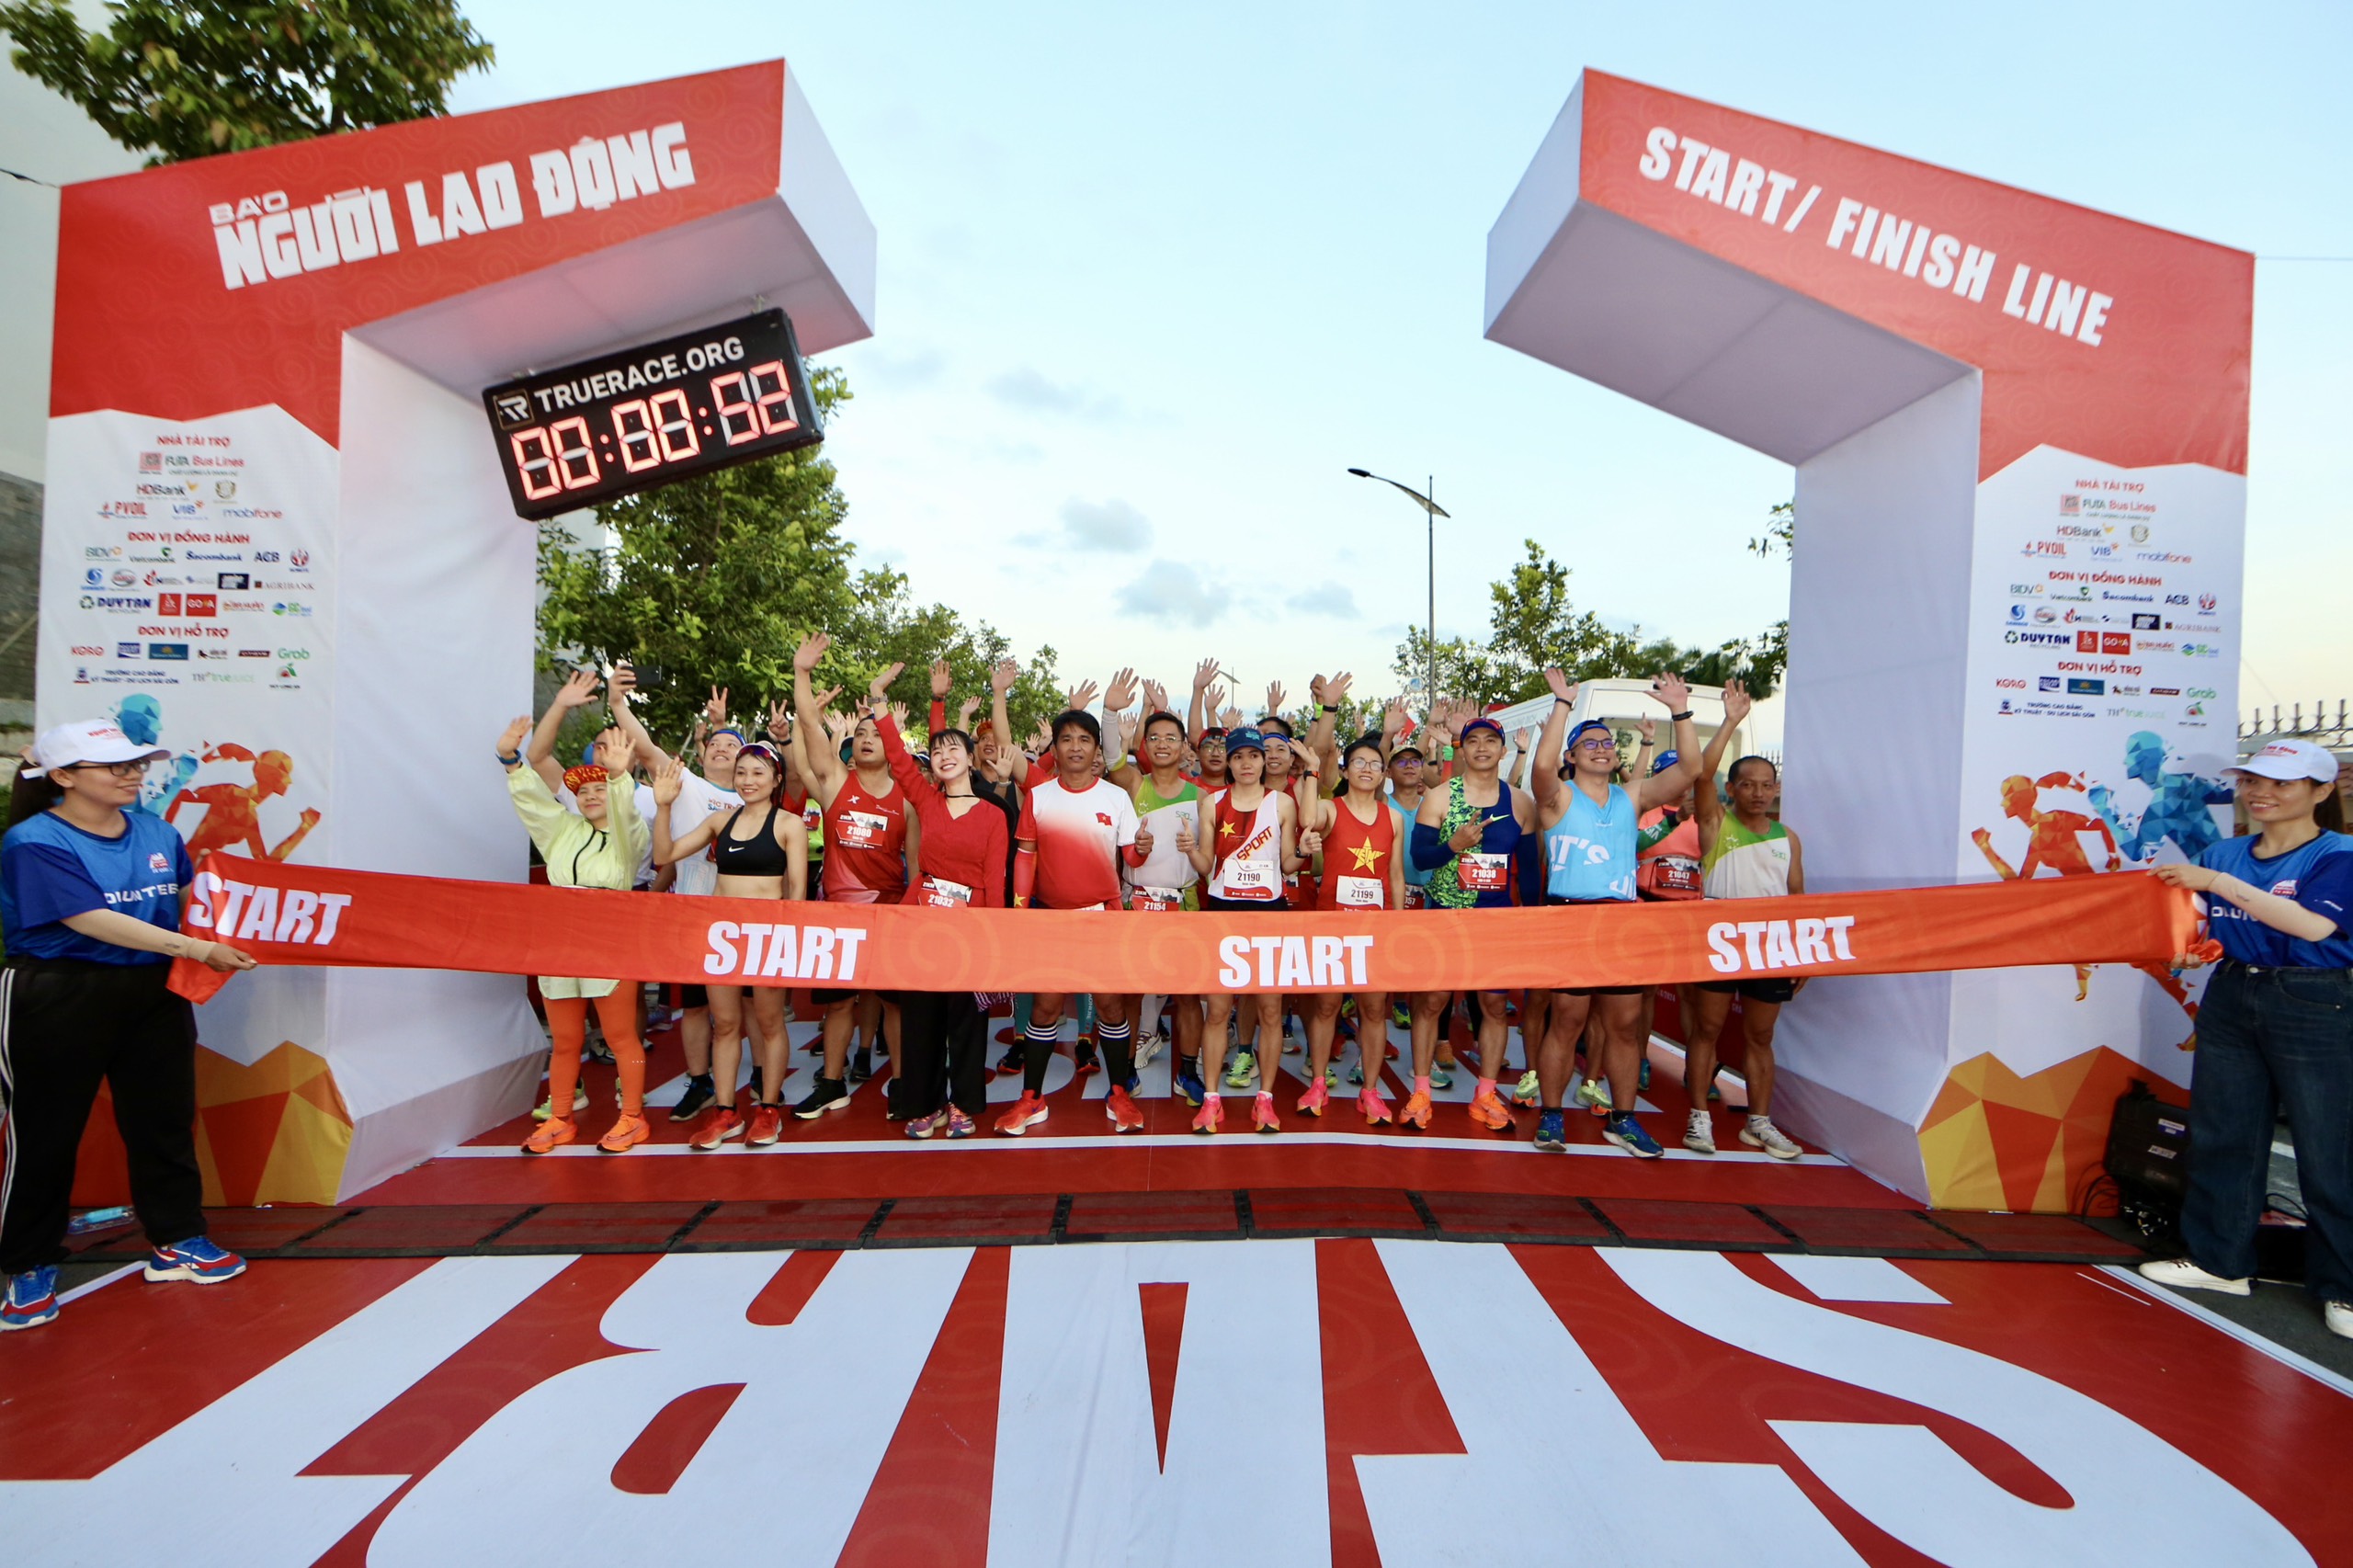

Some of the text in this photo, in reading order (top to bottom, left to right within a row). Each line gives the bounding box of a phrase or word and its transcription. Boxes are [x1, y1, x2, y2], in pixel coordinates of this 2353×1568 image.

[404, 161, 524, 246] LAO
[529, 121, 696, 219] ĐỘNG
[1639, 127, 2114, 347] START/ FINISH LINE
[534, 336, 745, 413] TRUERACE.ORG
[157, 433, 182, 446] NHÀ
[192, 456, 213, 467] Bus
[137, 483, 186, 496] HDBank
[2075, 478, 2099, 490] NHÀ
[115, 502, 147, 516] PVOIL
[2083, 498, 2156, 513] FUTA Bus Lines
[214, 531, 250, 543] HÀNH
[2057, 525, 2102, 537] HDBank
[2038, 541, 2192, 563] PVOIL VIB mobifone
[2049, 569, 2162, 585] ĐƠN VỊ ĐỒNG HÀNH
[97, 597, 152, 608] DUYTAN
[2165, 594, 2189, 605] ACB
[2020, 632, 2071, 644] DUYTAN
[278, 647, 310, 659] Grab
[2058, 661, 2084, 672] ĐƠN
[2086, 663, 2097, 674] VỊ
[2120, 665, 2143, 676] TRỢ
[2187, 687, 2216, 699] Grab
[847, 825, 872, 837] 21080
[1236, 826, 1273, 860] SPORT
[1237, 872, 1260, 881] 21190
[1472, 869, 1496, 879] 21038
[1668, 869, 1690, 880] 21047
[927, 894, 954, 907] 21032
[1350, 889, 1374, 899] 21199
[188, 871, 352, 946] START
[1144, 901, 1166, 911] 21154
[1708, 915, 1857, 972] START
[703, 920, 867, 981] START
[1219, 936, 1373, 988] START
